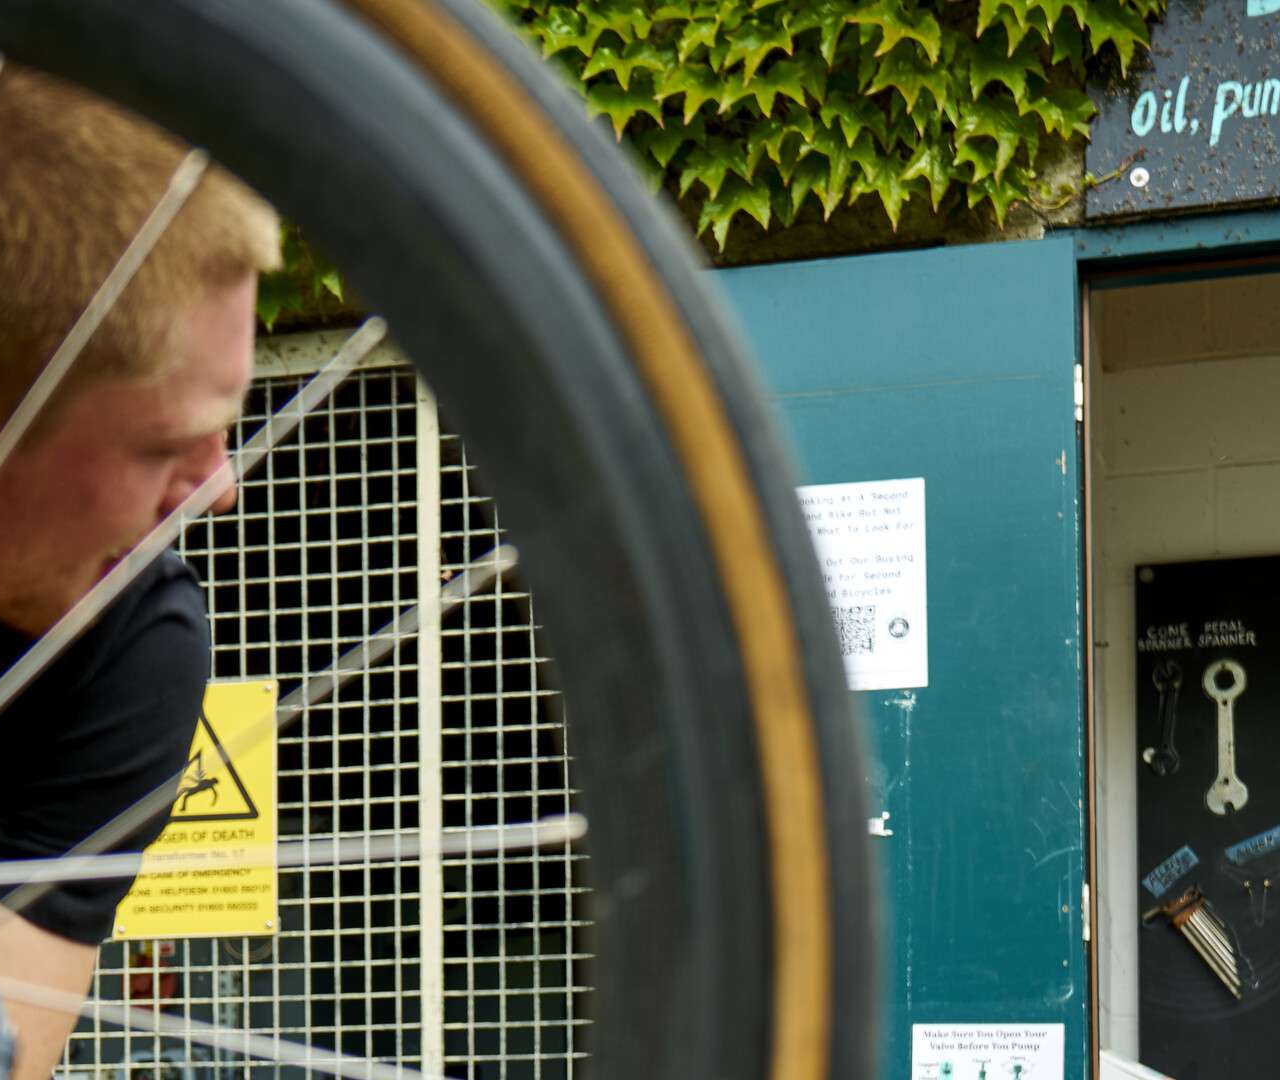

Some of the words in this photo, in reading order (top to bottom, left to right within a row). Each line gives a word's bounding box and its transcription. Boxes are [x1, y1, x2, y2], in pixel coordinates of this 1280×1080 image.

[1131, 75, 1198, 137] Oil,
[871, 491, 909, 500] Second
[865, 523, 889, 532] Look
[864, 570, 902, 579] Second
[841, 588, 892, 598] Bicycles
[1146, 623, 1190, 639] CONE
[1204, 620, 1245, 633] PEDAL
[1137, 637, 1193, 652] SPANNER
[1198, 631, 1256, 648] SPANNER
[191, 830, 208, 843] OF
[213, 829, 256, 842] DEATH
[924, 1030, 949, 1038] Make
[951, 1030, 975, 1038] Sure
[977, 1030, 994, 1038] You
[996, 1030, 1021, 1040] Open
[930, 1042, 955, 1050] Valve
[958, 1042, 990, 1050] Before
[992, 1042, 1009, 1050] You
[1011, 1043, 1040, 1052] Pump
